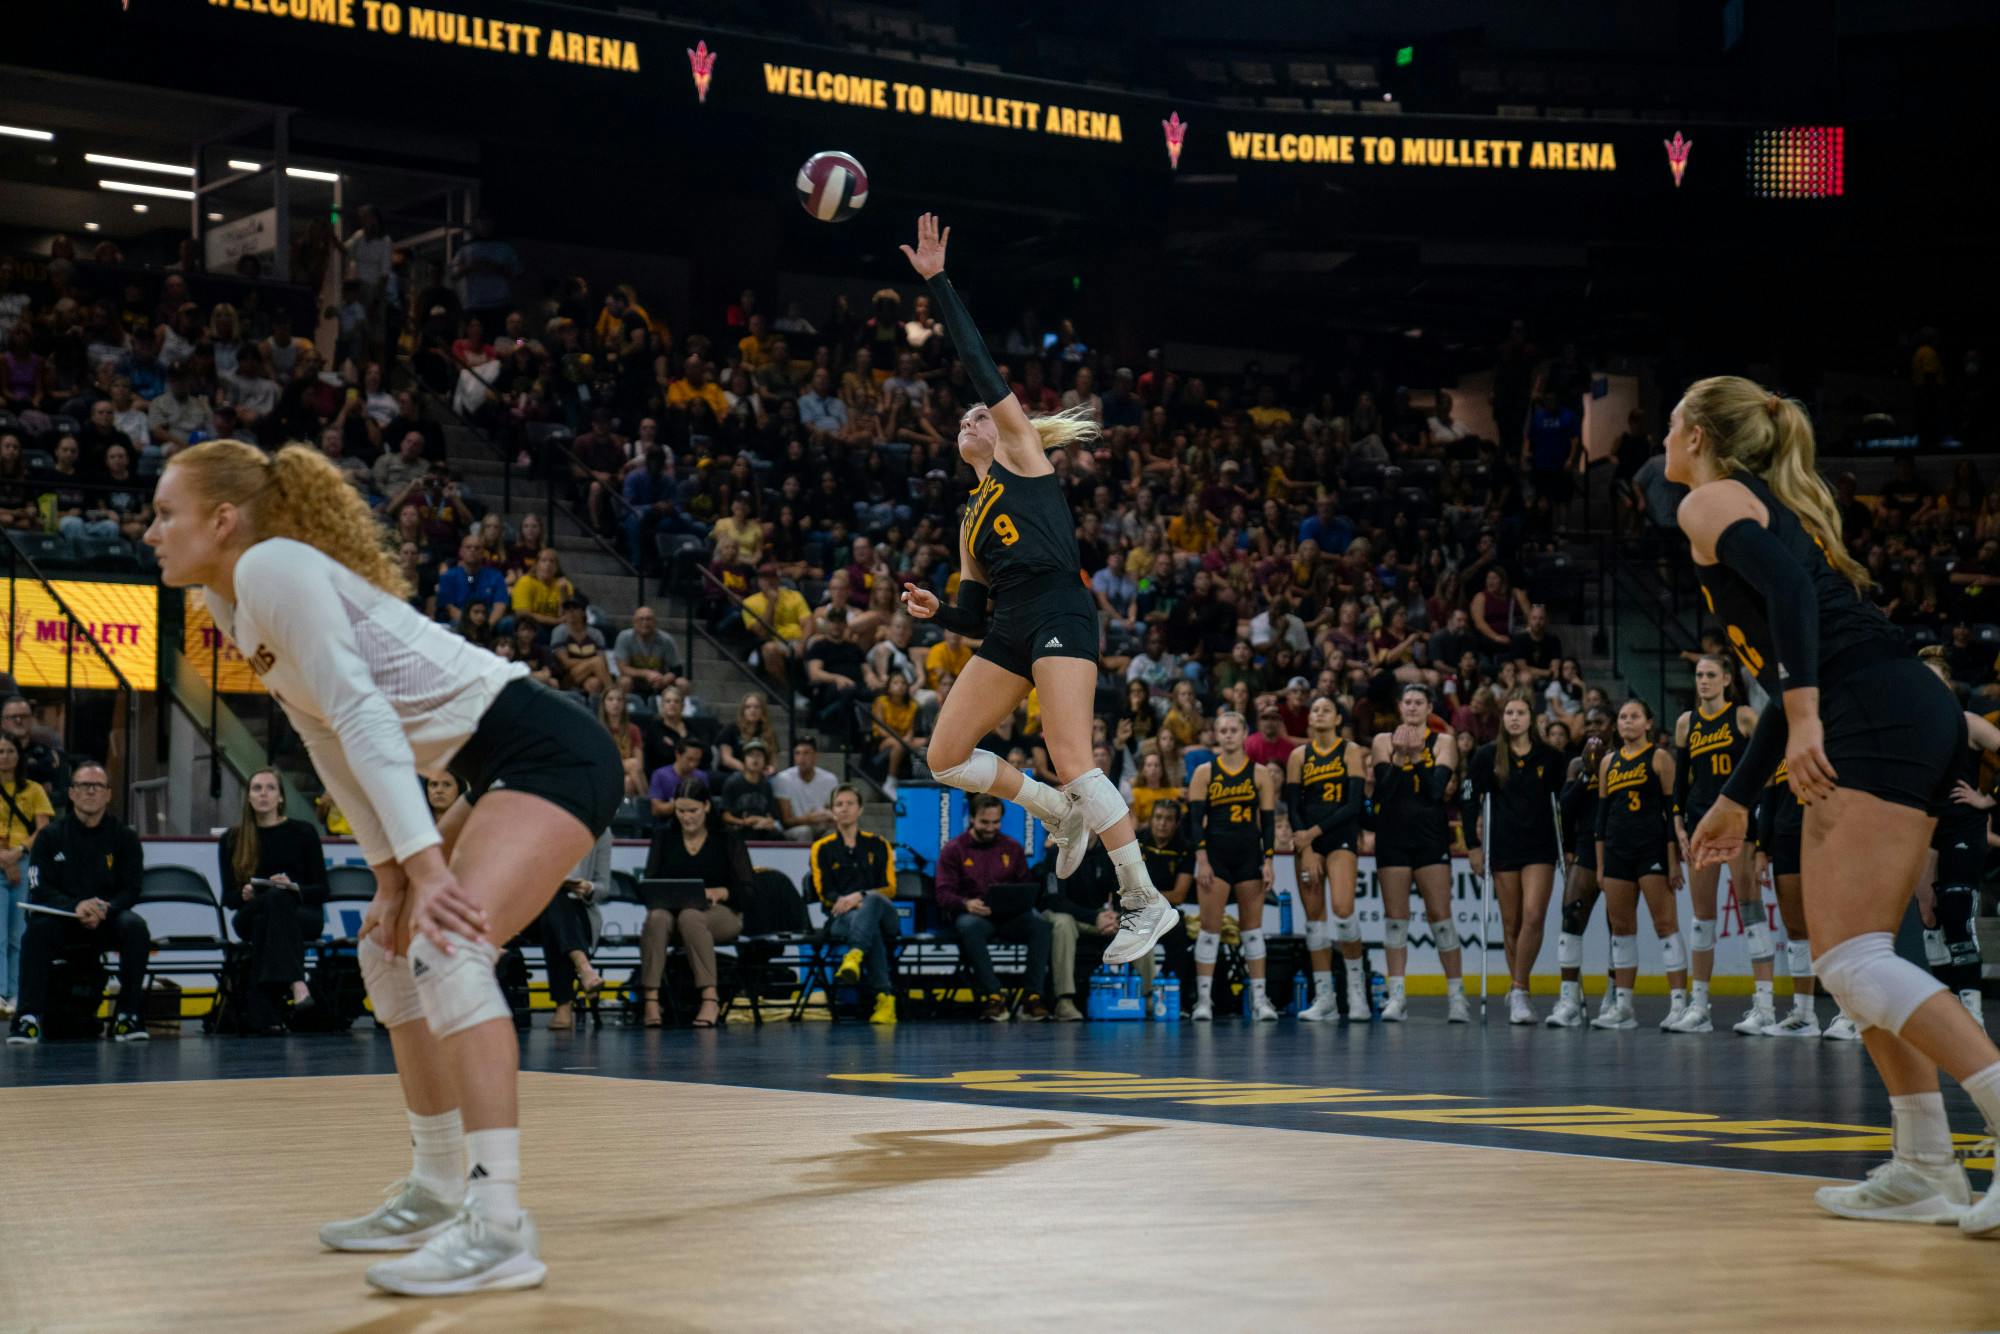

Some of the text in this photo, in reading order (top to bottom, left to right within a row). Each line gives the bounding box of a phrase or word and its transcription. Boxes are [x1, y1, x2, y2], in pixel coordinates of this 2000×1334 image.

[363, 0, 400, 34] TO
[409, 7, 541, 56] MULLETT
[548, 31, 639, 72] ARENA
[763, 63, 1122, 143] WELCOME TO MULLETT ARENA
[1227, 131, 1617, 170] WELCOME TO MULLETT ARENA
[993, 513, 1020, 546] 9
[1711, 753, 1732, 776] 10
[1322, 782, 1343, 802] 21
[1627, 790, 1642, 812] 3
[1230, 804, 1253, 823] 24
[826, 1069, 1489, 1106] SUN
